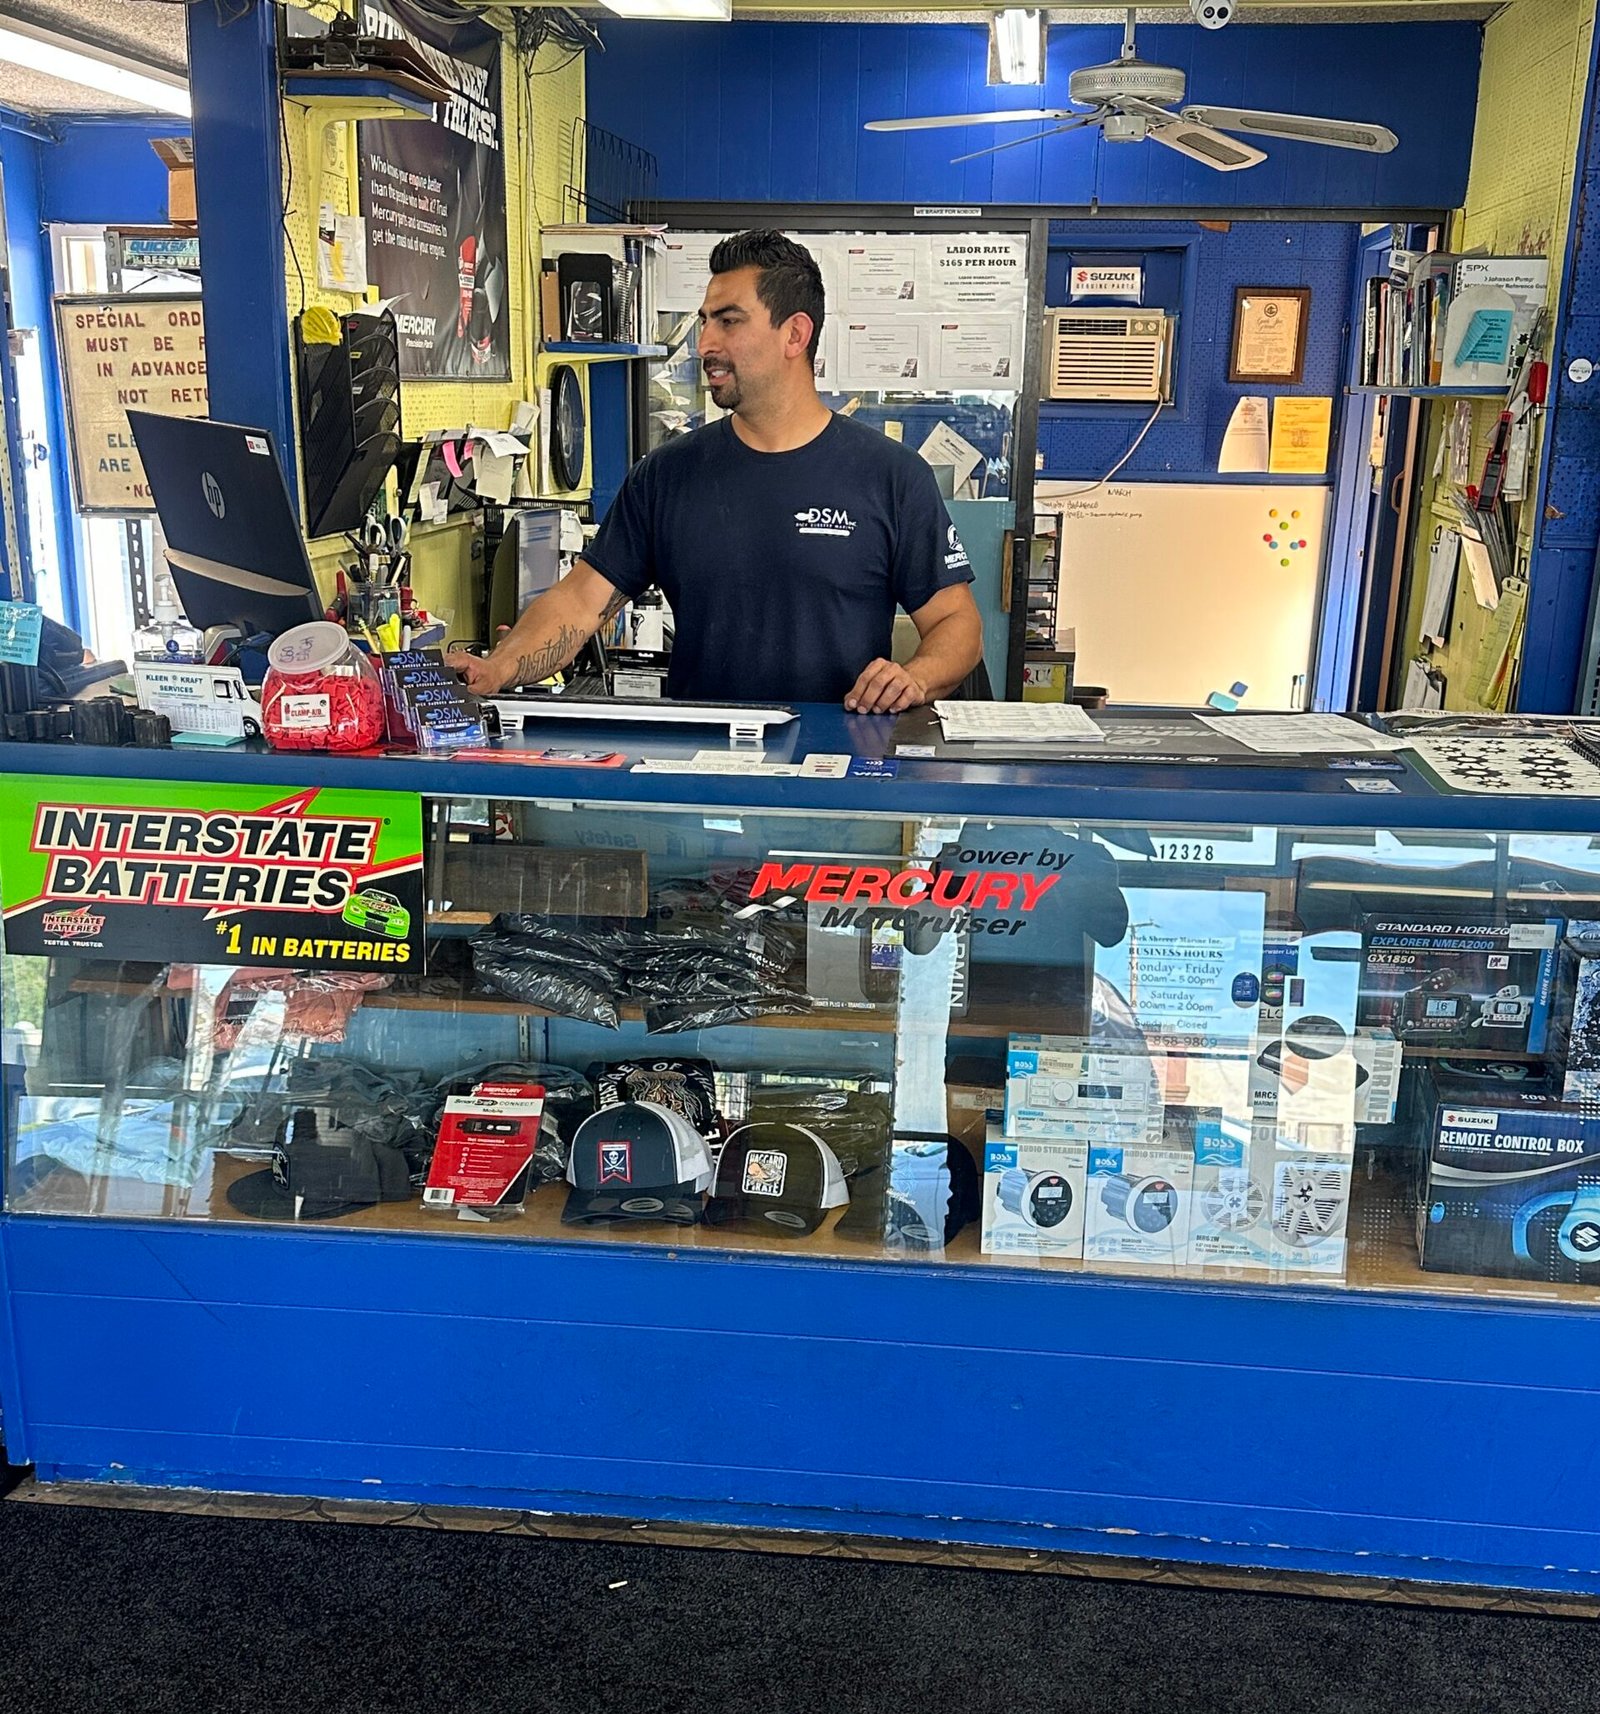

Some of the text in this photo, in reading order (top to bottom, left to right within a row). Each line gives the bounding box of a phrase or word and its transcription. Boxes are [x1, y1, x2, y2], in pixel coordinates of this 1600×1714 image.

[444, 91, 469, 138] THE
[372, 201, 398, 228] Mercury
[372, 229, 384, 247] get
[946, 246, 1010, 254] LABOR RATE
[939, 259, 1017, 267] $165 PER HOUR
[1465, 264, 1490, 272] SPX
[1090, 272, 1135, 281] SUZUKI
[1488, 275, 1534, 284] Johnson Pump
[75, 312, 145, 329] SPECIAL
[395, 314, 436, 336] MERCURY
[86, 336, 174, 353] MUST BE
[97, 361, 206, 377] IN ADVANCE
[118, 388, 148, 404] NOT
[98, 458, 131, 472] ARE
[808, 507, 849, 525] DSM
[398, 651, 428, 663] DSM
[146, 674, 203, 685] KLEEN KRAFT
[411, 670, 441, 684] DSM
[159, 685, 194, 694] SERVICES
[424, 689, 455, 702] DSM
[434, 707, 463, 721] DSM
[1060, 754, 1182, 762] MERCURY
[38, 808, 373, 861] INTERSTATE
[939, 842, 1076, 870] Power by
[1159, 844, 1214, 861] 12328
[51, 857, 352, 909] BATTERIES
[749, 862, 1062, 911] MERCURY
[44, 915, 102, 925] INTERSTATE
[819, 905, 1027, 937] MerCruiser
[47, 923, 98, 933] BATTERIES
[1375, 923, 1452, 934] STANDARD
[44, 939, 104, 948] TESTED. TRUSTED.
[215, 920, 411, 963] #1 IN BATTERIES
[1370, 937, 1495, 950] EXPLORER NMEA2000
[948, 905, 968, 1009] GARMIN
[1128, 947, 1224, 959] BUSINESS HOURS
[1367, 954, 1416, 964] GX1850
[1127, 961, 1176, 977] Monday
[1185, 963, 1223, 978] Friday
[1150, 990, 1195, 1001] Saturday
[1540, 978, 1550, 1007] MARINE
[1435, 1000, 1448, 1011] 16
[1176, 1019, 1208, 1030] Closed
[652, 1062, 683, 1072] OF
[1014, 1060, 1034, 1068] BOSS
[1367, 1040, 1395, 1122] MARINE
[1457, 1116, 1494, 1125] SUZUKI
[1203, 1137, 1236, 1148] BOSS
[1439, 1130, 1491, 1148] REMOTE
[1494, 1134, 1554, 1152] CONTROL
[1556, 1138, 1585, 1154] BOX
[1018, 1145, 1087, 1155] AUDIO STREAMING
[1124, 1150, 1194, 1161] AUDIO STREAMING
[750, 1153, 784, 1170] HAGGARD
[990, 1153, 1012, 1161] BOSS
[1095, 1158, 1118, 1166] BOSS
